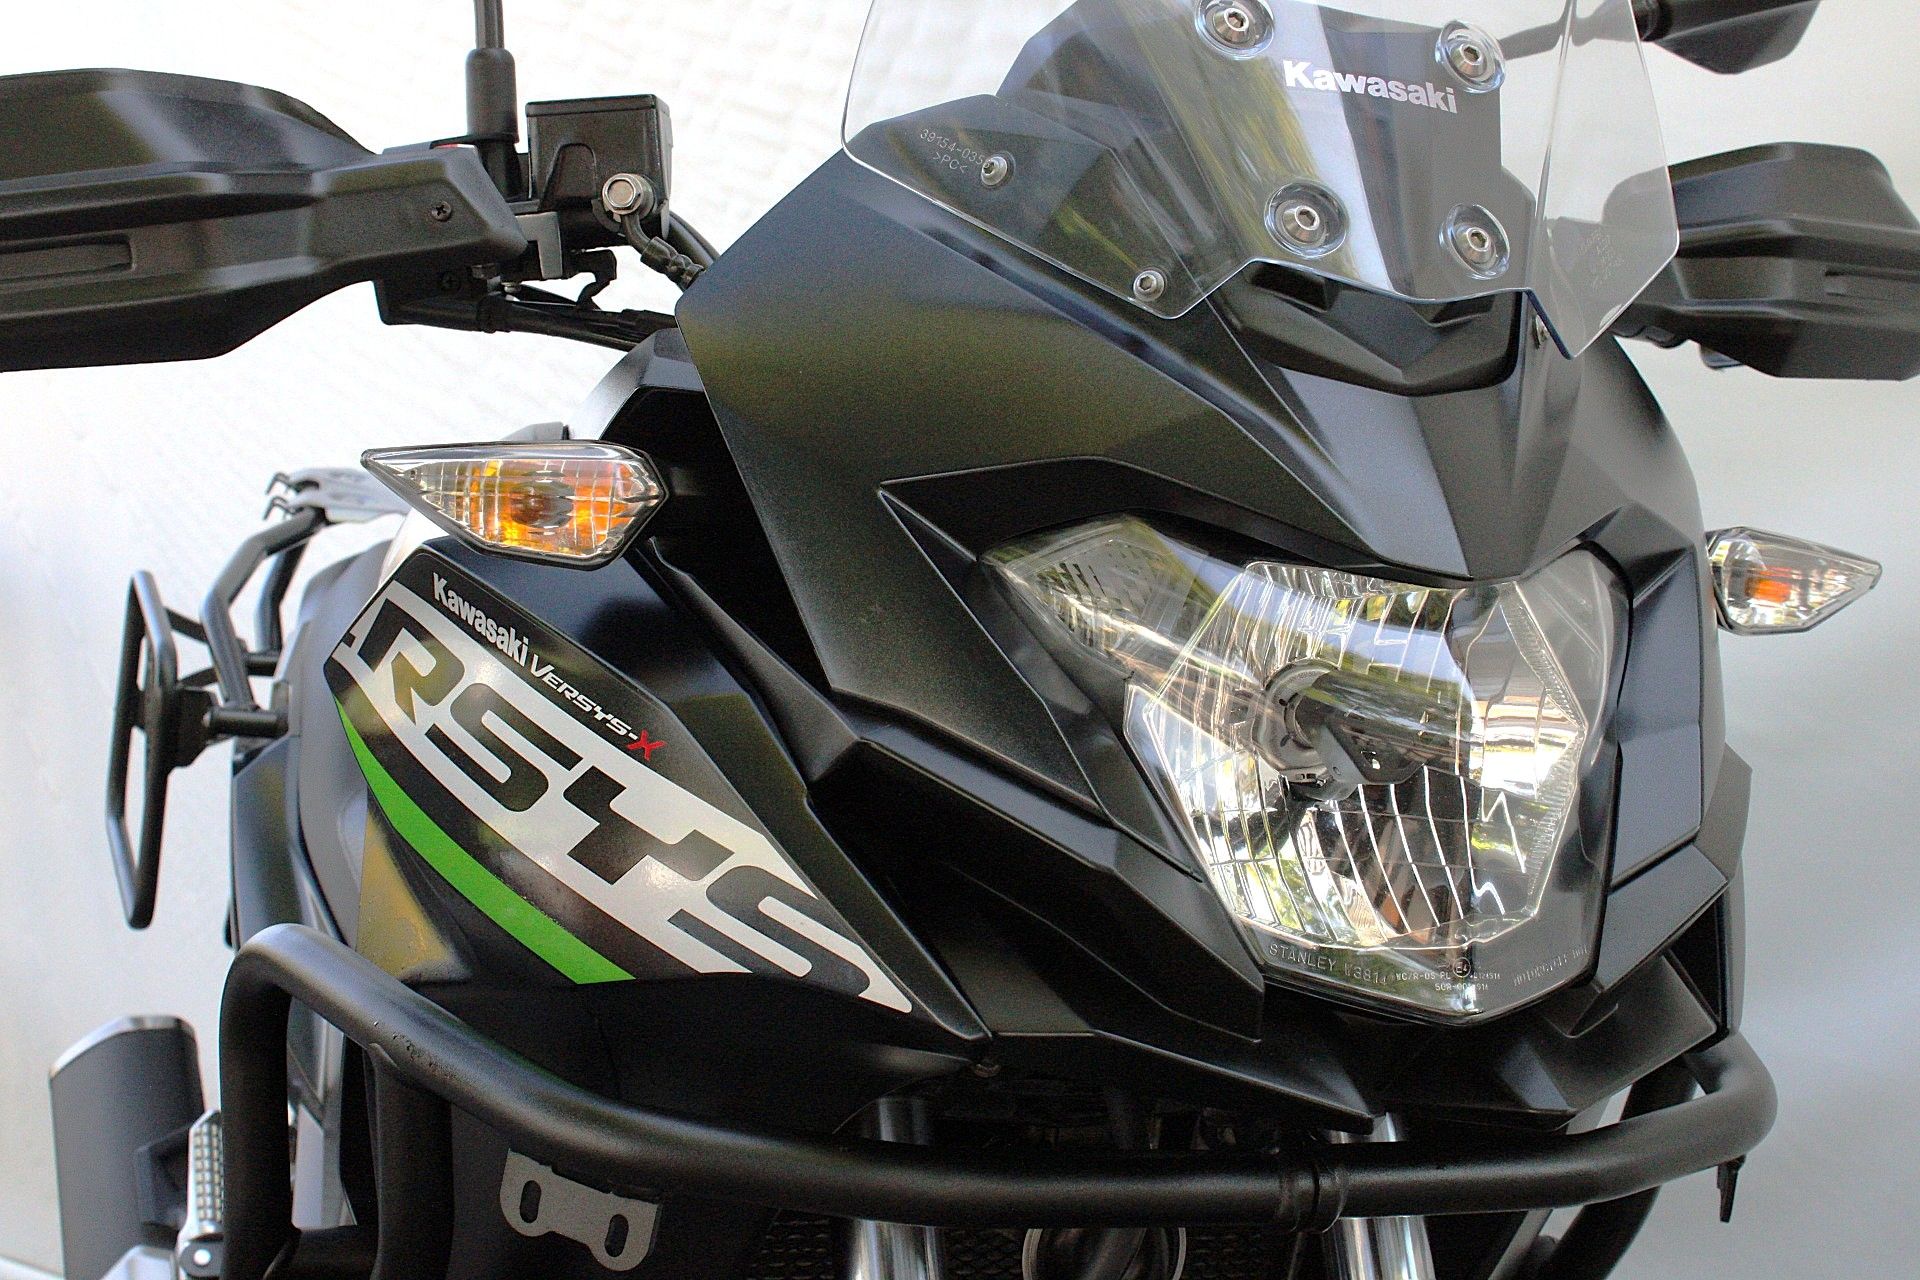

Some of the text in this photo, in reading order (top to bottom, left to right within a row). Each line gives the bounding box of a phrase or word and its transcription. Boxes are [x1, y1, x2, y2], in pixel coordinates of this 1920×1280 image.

[1283, 60, 1457, 113] Kawasaki
[433, 572, 529, 667] Kawasaki
[1269, 943, 1337, 972] STANLEY
